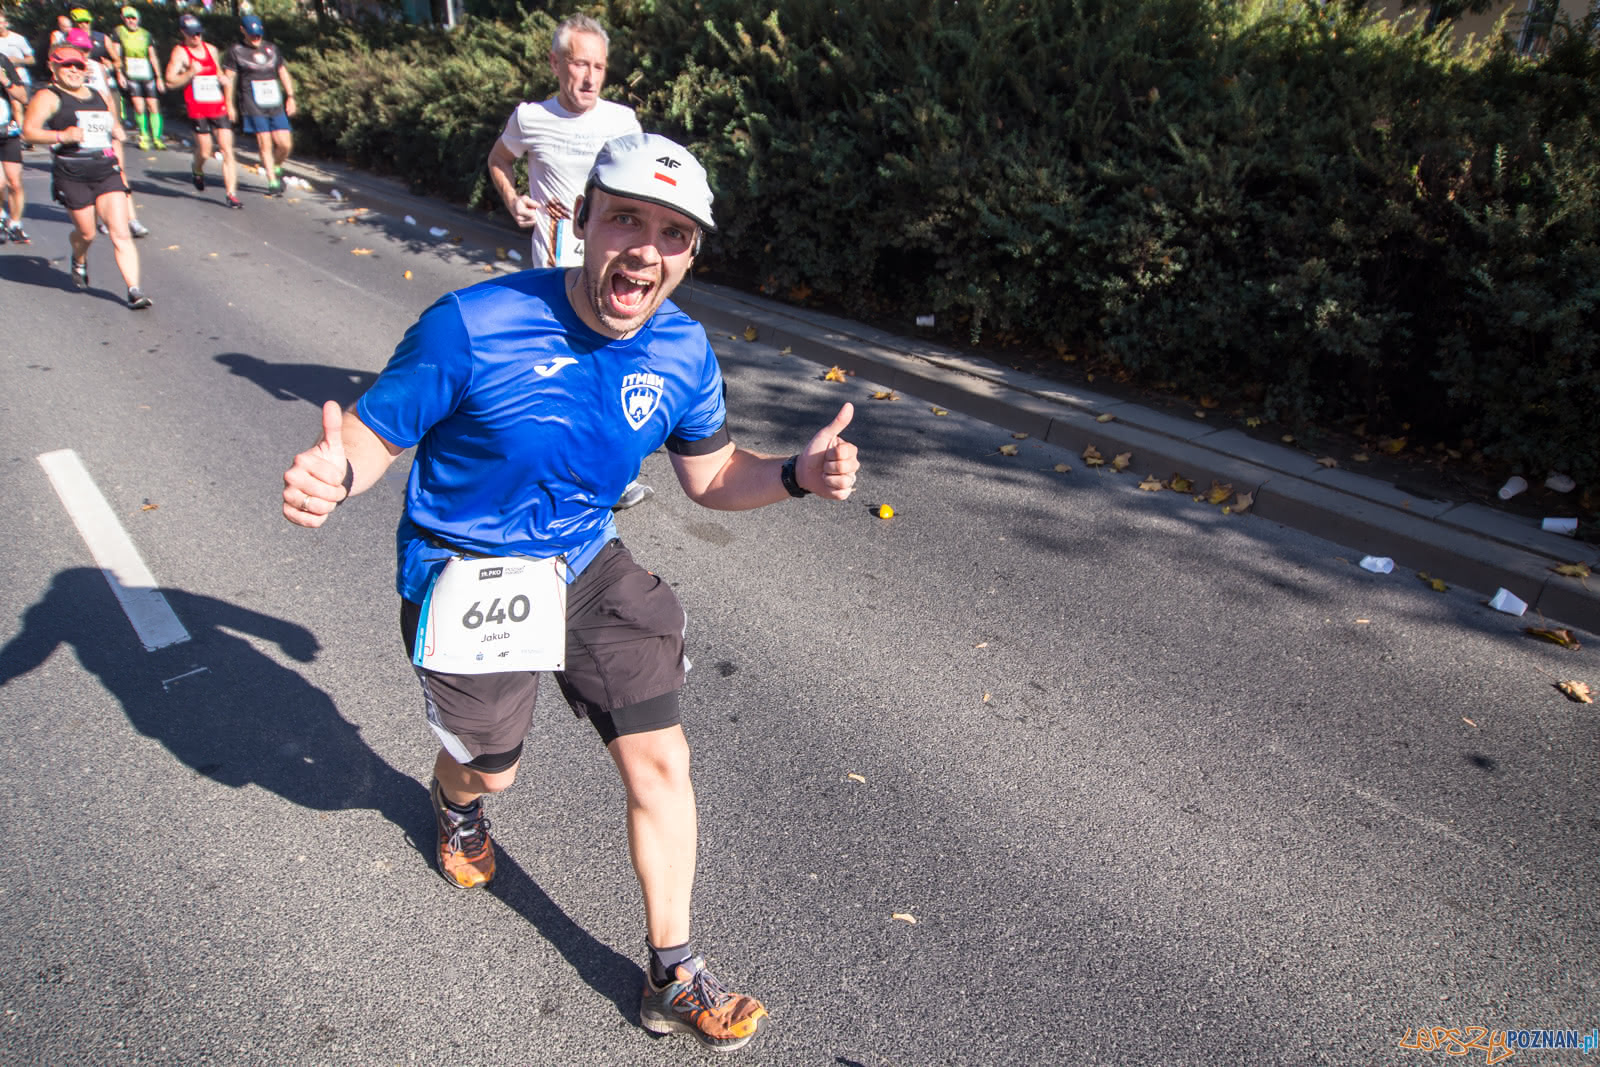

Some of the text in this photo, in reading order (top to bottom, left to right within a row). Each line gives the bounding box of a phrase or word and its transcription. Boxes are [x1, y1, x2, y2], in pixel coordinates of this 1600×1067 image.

[655, 156, 682, 169] 4F
[488, 569, 502, 577] PKO
[462, 594, 531, 630] 640
[480, 631, 511, 643] Jakub
